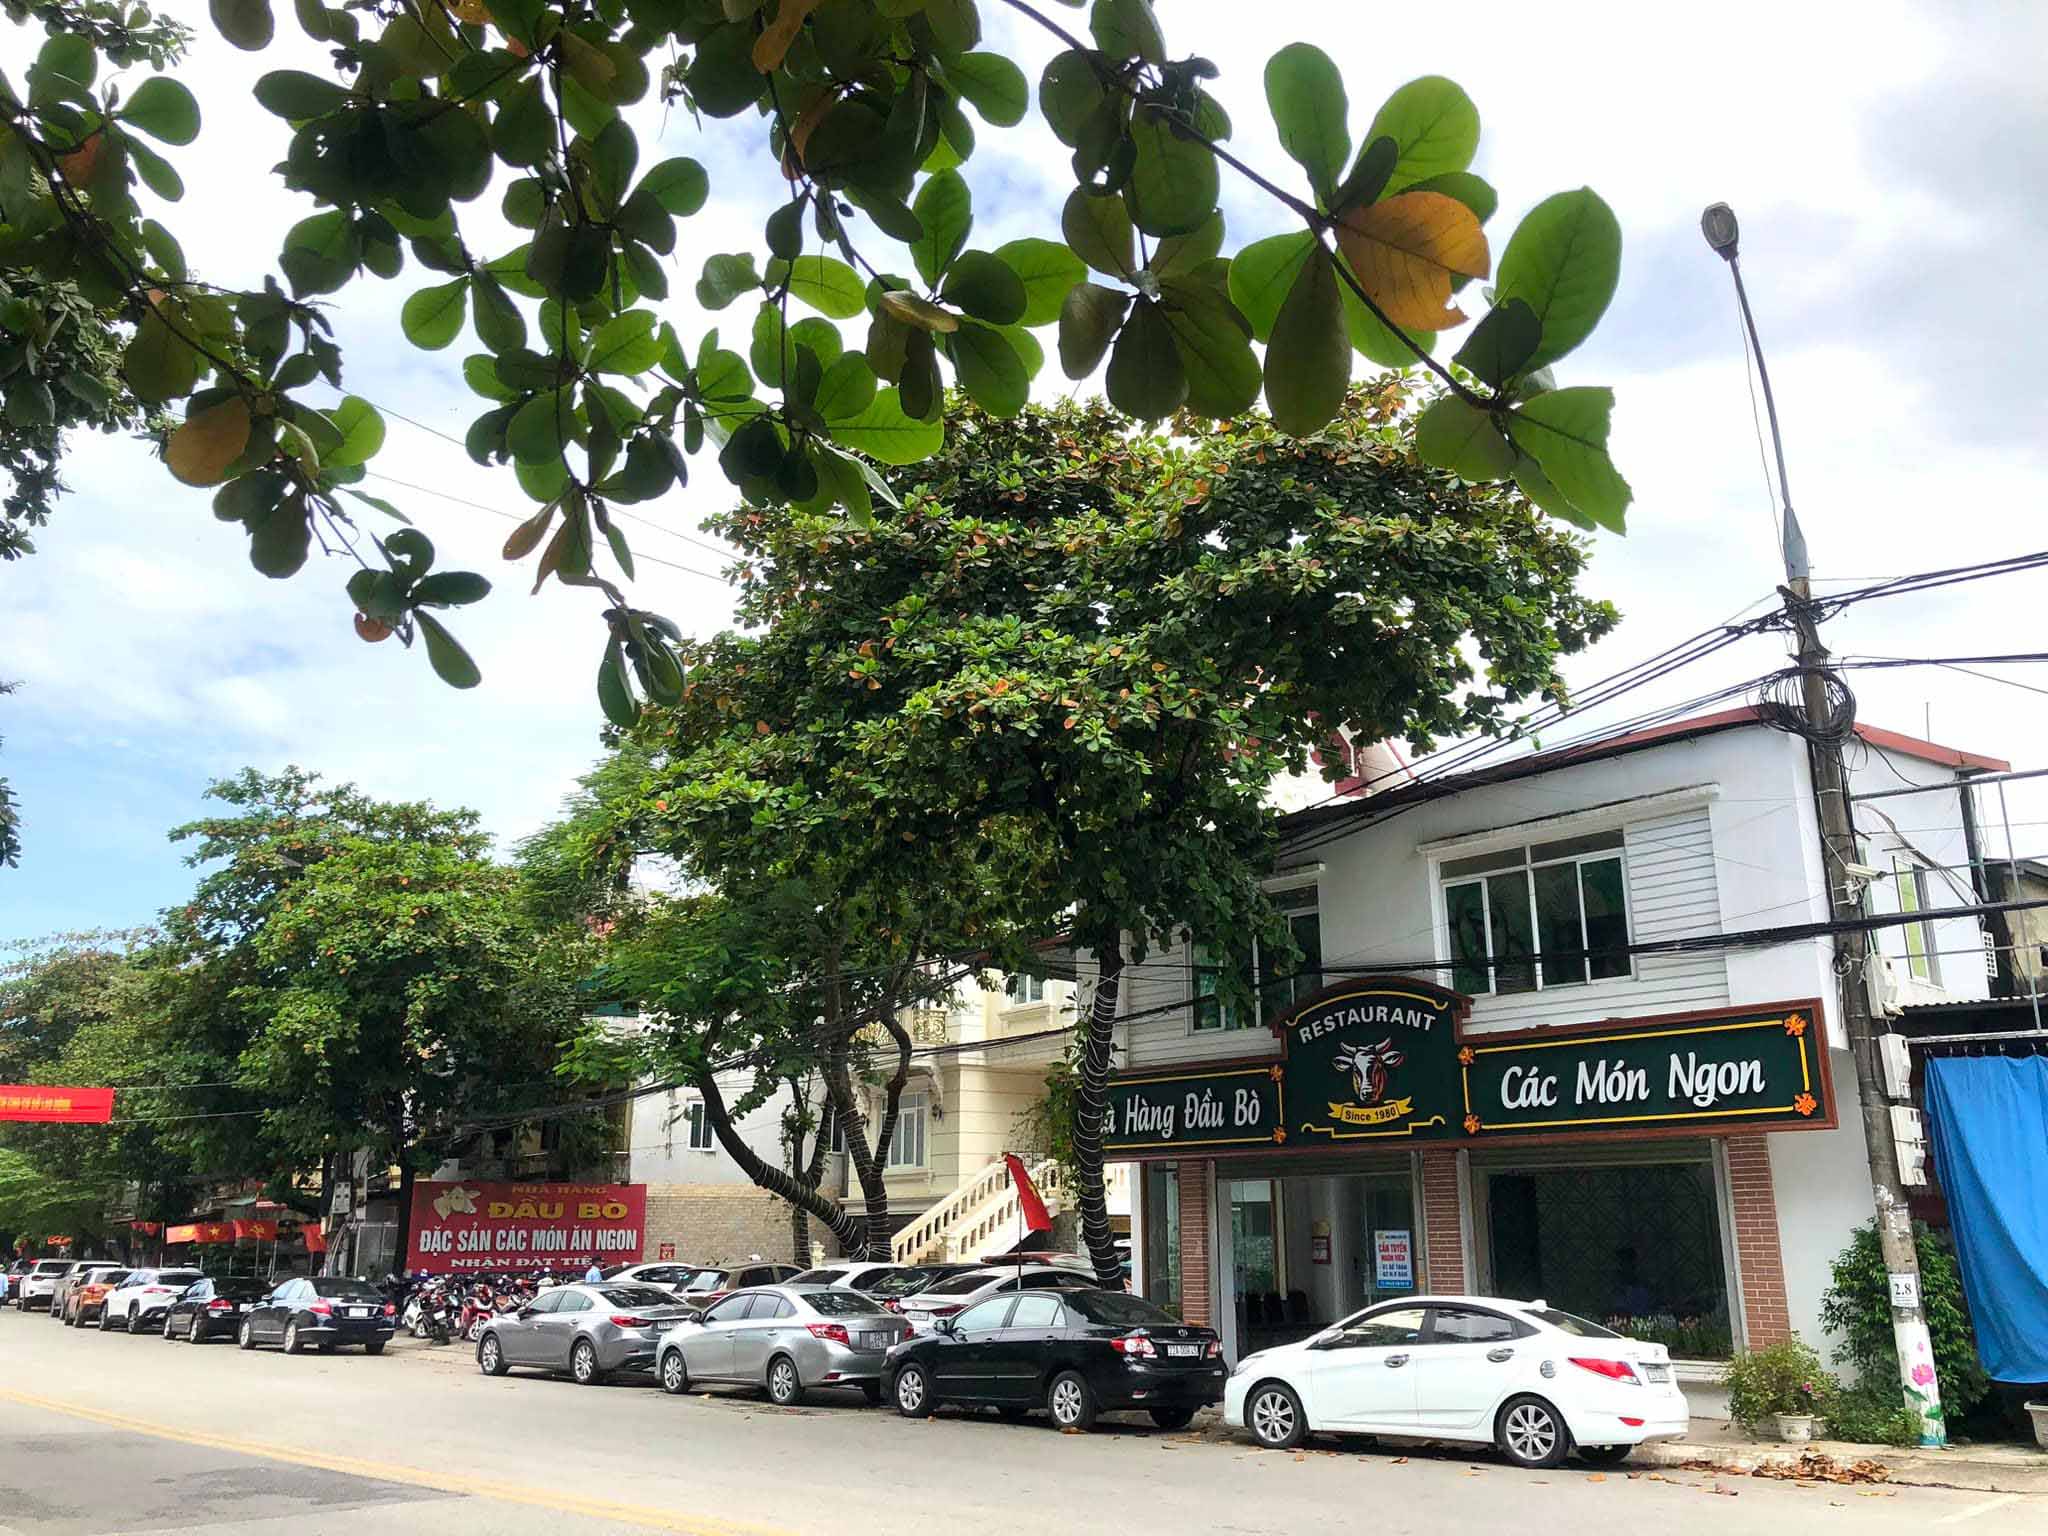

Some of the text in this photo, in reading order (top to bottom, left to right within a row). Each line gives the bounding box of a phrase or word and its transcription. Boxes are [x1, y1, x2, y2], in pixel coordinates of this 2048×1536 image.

[1299, 1005, 1437, 1044] RESTAURANT
[1500, 1051, 1766, 1110] Các Món Ngon
[1124, 1094, 1175, 1139] Hàng
[1184, 1087, 1225, 1129] Đầu
[1234, 1088, 1261, 1127] Bò
[1345, 1111, 1372, 1121] Since
[578, 1198, 628, 1219] BÒ
[419, 1222, 637, 1256] ĐẶC SẢN CÁC MÓN ĂN NGON
[561, 1255, 593, 1267] TIỆ
[1894, 1283, 1912, 1295] 2.8
